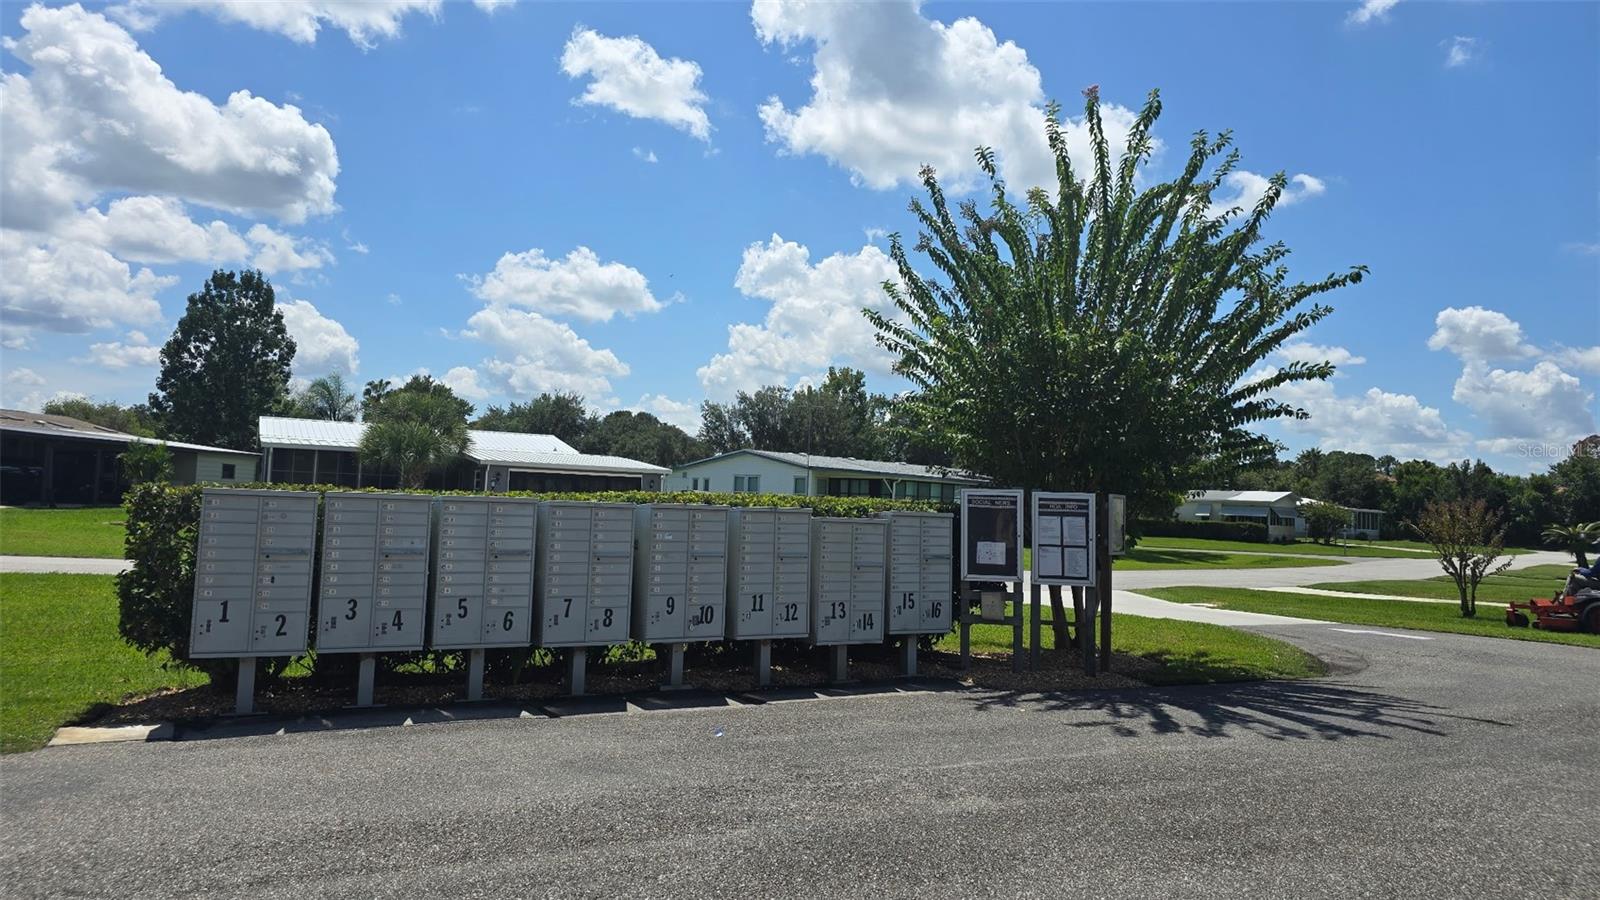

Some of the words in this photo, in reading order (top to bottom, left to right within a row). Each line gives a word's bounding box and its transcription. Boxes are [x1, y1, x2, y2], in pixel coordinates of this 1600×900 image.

[971, 498, 992, 507] SOCIAL
[994, 499, 1011, 507] NEWS
[345, 599, 358, 620] 3
[457, 598, 468, 618] 5
[563, 598, 573, 618] 7
[666, 597, 675, 615] 9
[751, 594, 764, 612] 11
[831, 602, 846, 619] 13
[903, 593, 915, 610] 15
[931, 602, 942, 618] 16
[219, 600, 230, 623] 1
[392, 610, 404, 631] 4
[503, 611, 514, 631] 6
[602, 608, 613, 628] 8
[699, 605, 714, 624] 10
[784, 603, 798, 621] 12
[275, 614, 287, 636] 2
[863, 613, 874, 631] 14
